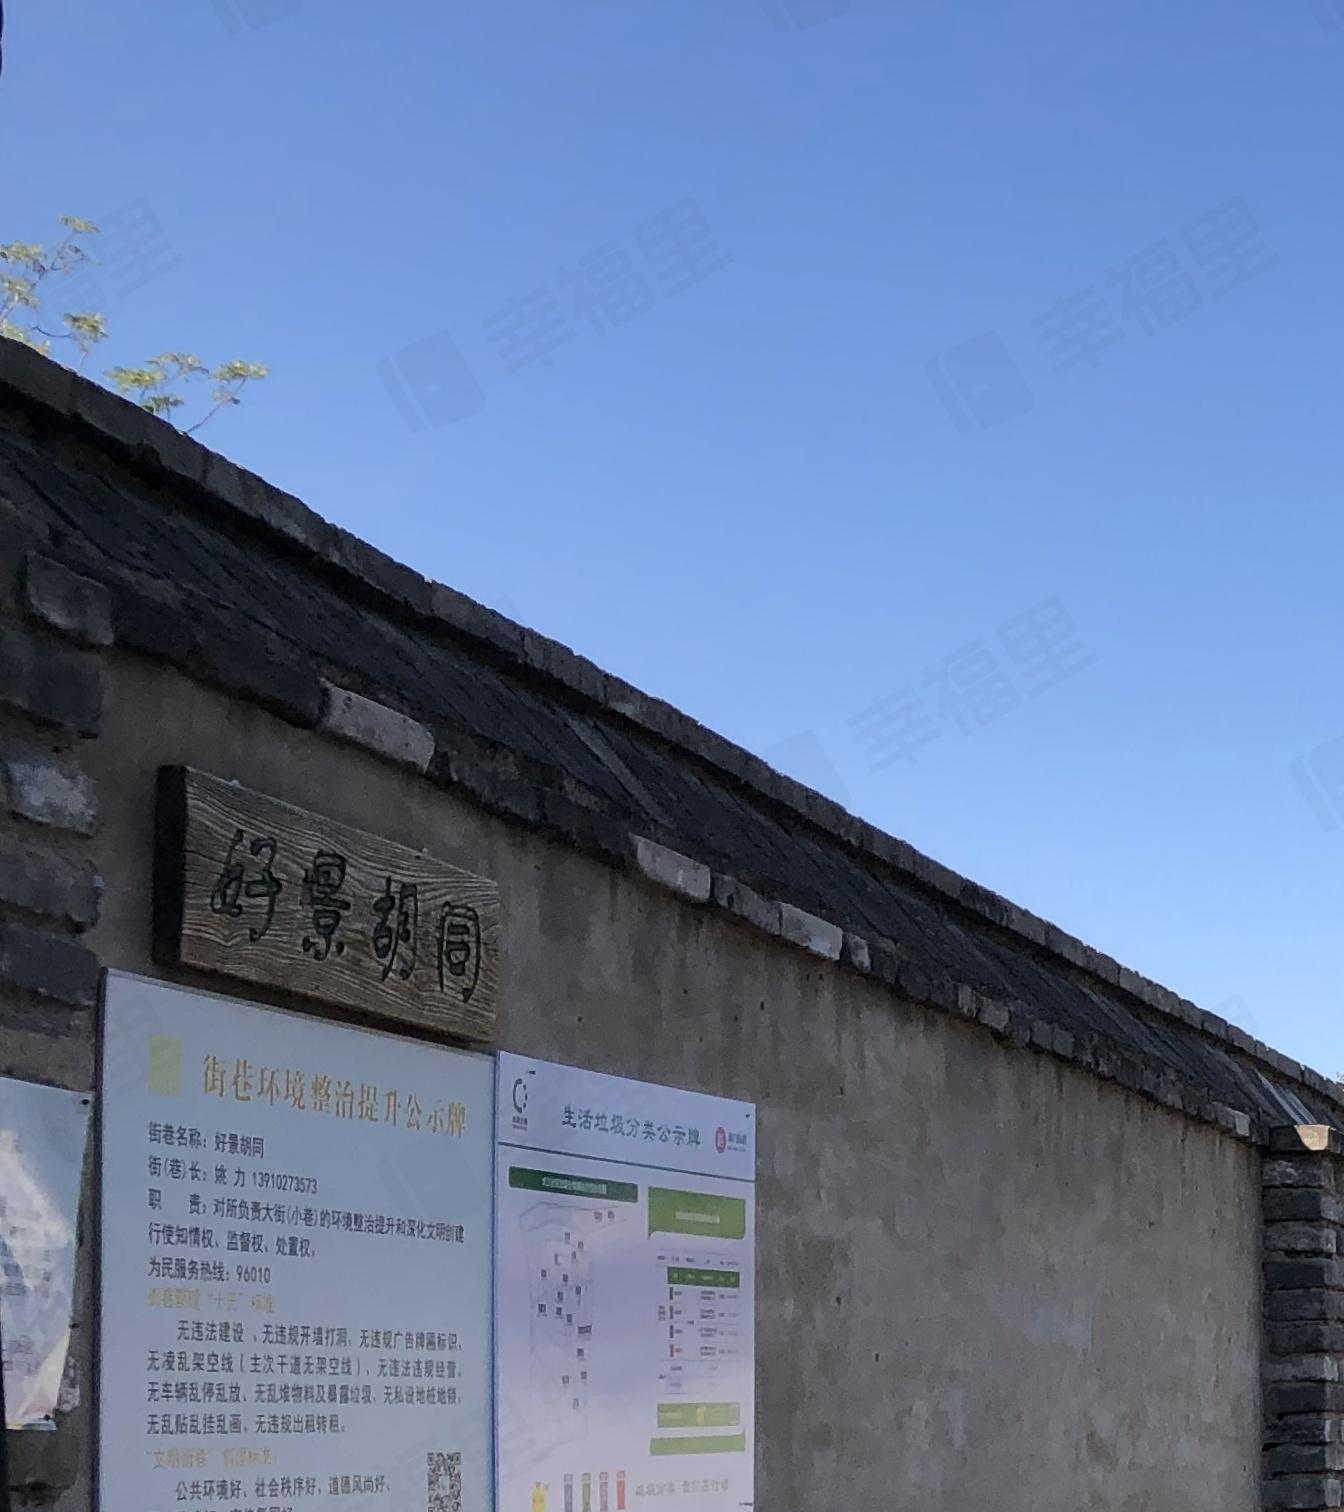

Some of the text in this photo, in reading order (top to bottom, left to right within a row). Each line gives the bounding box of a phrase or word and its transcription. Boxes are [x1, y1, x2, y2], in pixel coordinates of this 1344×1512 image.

[211, 829, 481, 1003] 好景胡同
[203, 1054, 466, 1138] 街巷环境整治提升公示牌
[561, 1103, 701, 1150] 生活垃圾分类公示牌
[251, 1171, 318, 1195] 13910273573
